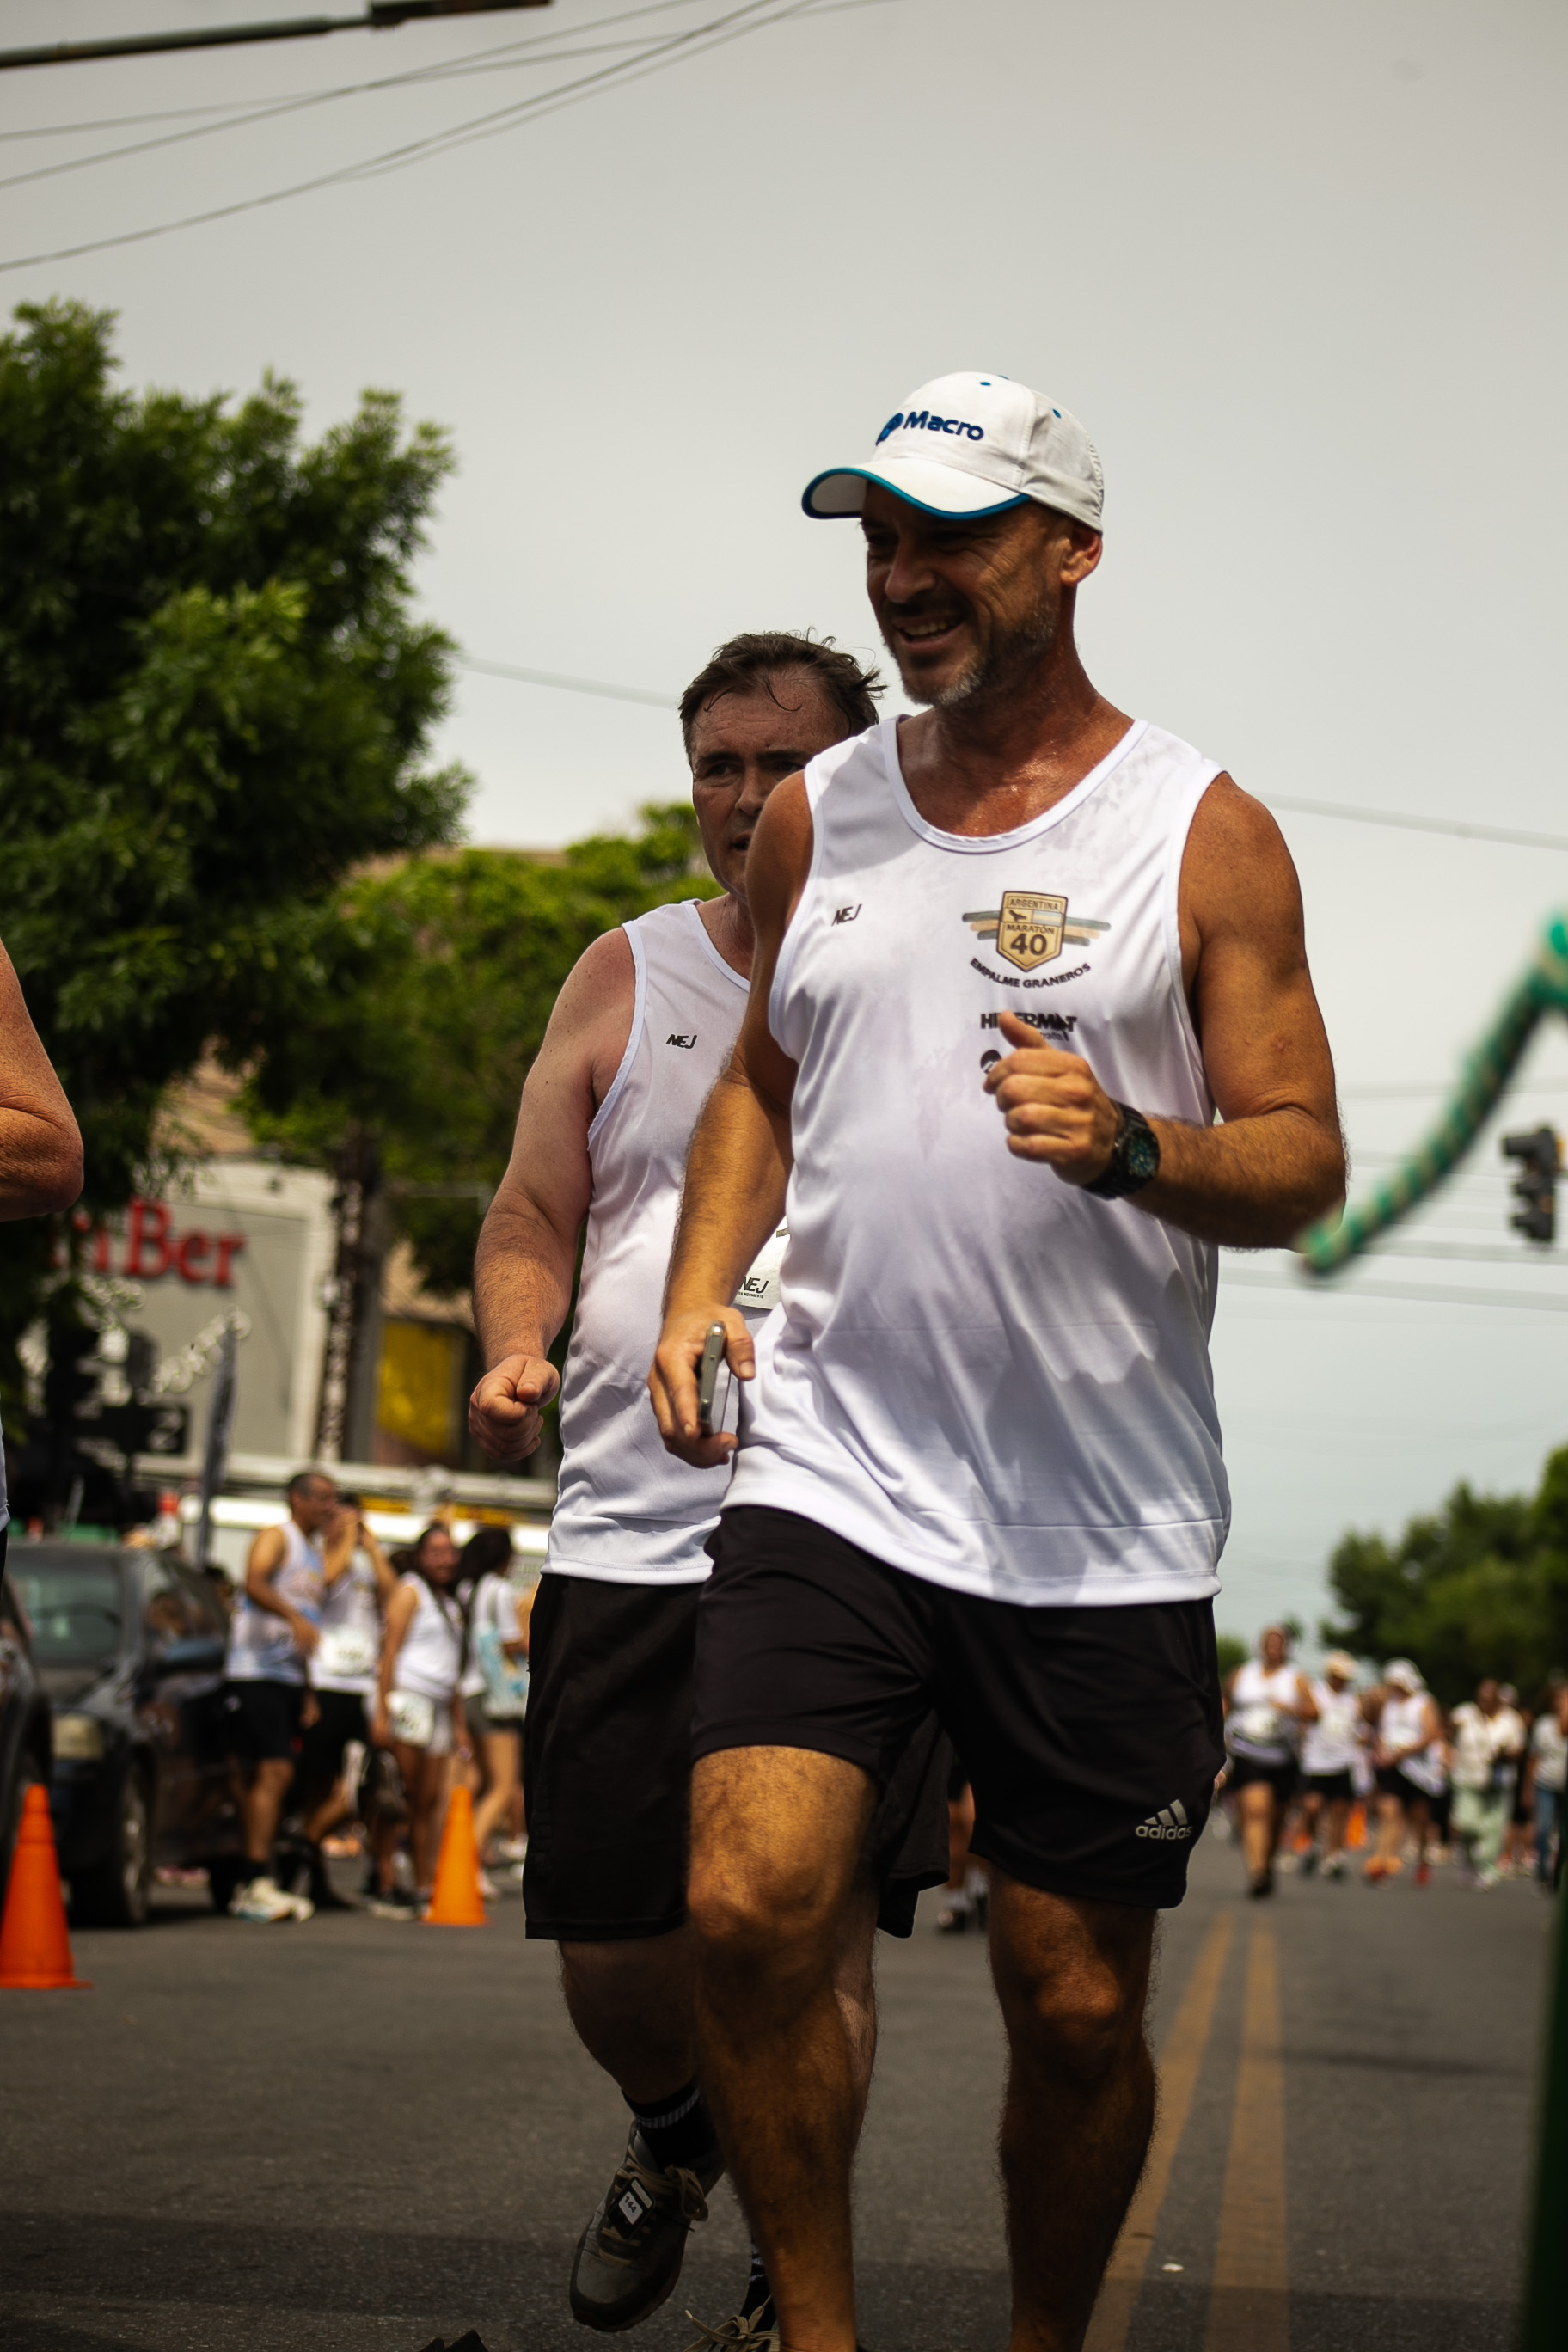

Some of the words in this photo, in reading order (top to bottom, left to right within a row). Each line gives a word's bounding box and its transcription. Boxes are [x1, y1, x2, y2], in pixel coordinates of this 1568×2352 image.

[903, 410, 984, 441] Macro
[831, 903, 862, 927] NEJ
[1010, 898, 1059, 911] ARGENTINA
[1010, 933, 1047, 956] 40
[970, 957, 1020, 988] EMPALME
[1023, 963, 1092, 989] GRANEROS
[981, 1012, 1078, 1032] HIRMAT
[665, 1034, 697, 1050] NEJ
[1136, 1824, 1192, 1840] adidas
